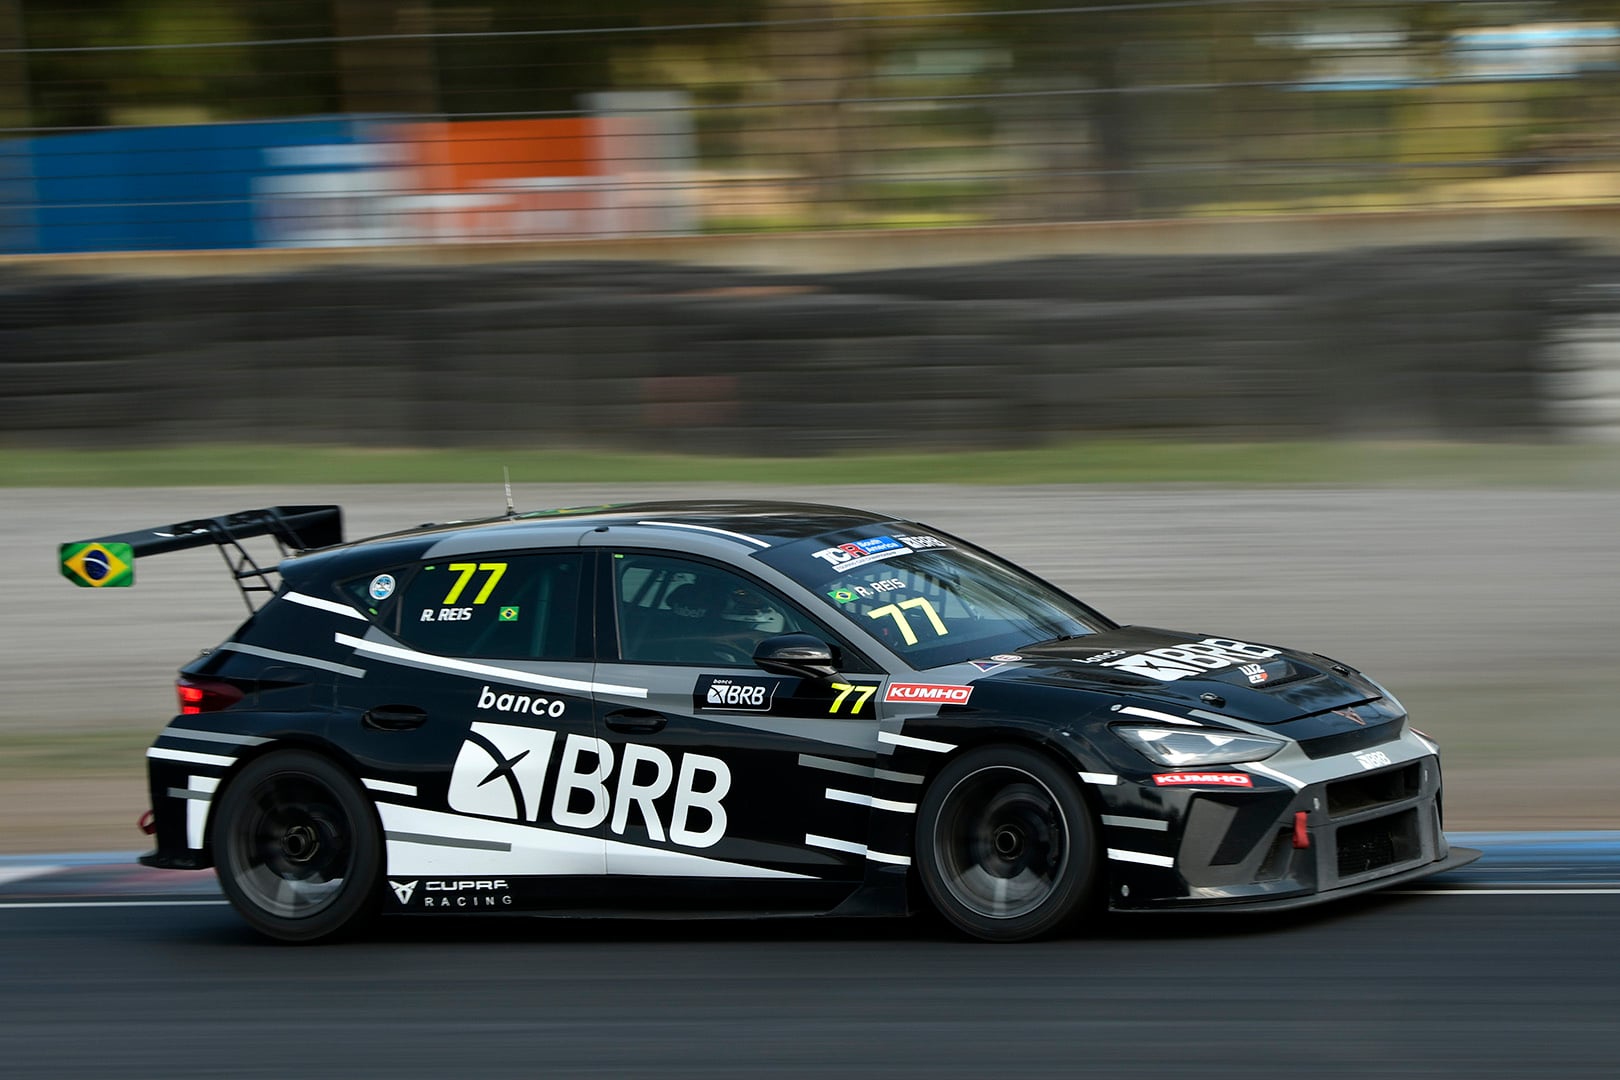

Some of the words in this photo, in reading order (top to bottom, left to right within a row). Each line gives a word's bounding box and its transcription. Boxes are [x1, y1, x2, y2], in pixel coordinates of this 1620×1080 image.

[811, 543, 870, 566] TCR
[442, 563, 508, 605] 77
[854, 586, 874, 598] R.
[870, 578, 906, 594] REIS
[420, 608, 435, 622] R.
[437, 607, 473, 622] REIS
[867, 596, 949, 646] 77
[1144, 638, 1283, 673] BRB
[477, 686, 565, 718] banco
[727, 685, 766, 706] BRB
[829, 682, 878, 714] 77
[889, 687, 968, 700] KUMHO
[551, 733, 732, 849] BRB
[1155, 774, 1249, 785] KUMHO
[424, 895, 512, 907] RACING
